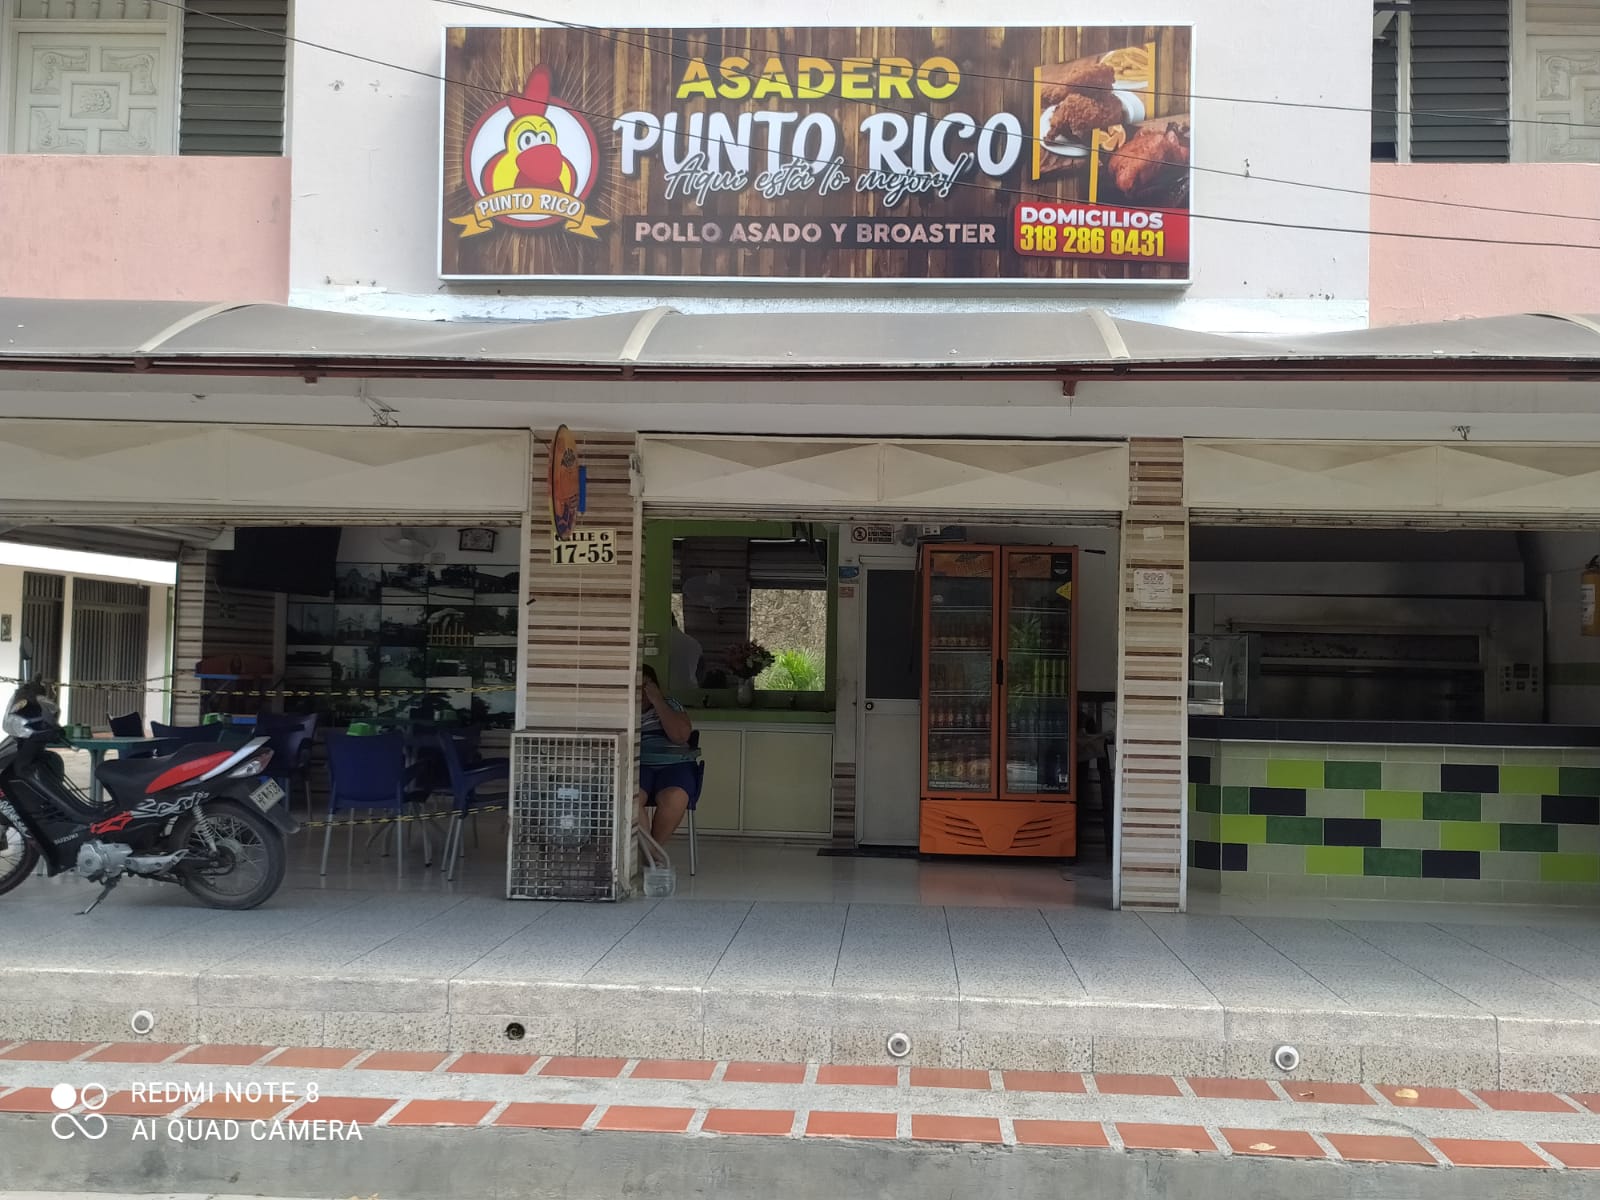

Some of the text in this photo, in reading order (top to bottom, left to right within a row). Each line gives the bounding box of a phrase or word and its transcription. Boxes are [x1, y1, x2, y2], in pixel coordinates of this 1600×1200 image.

[676, 57, 960, 99] ASADERO
[613, 111, 1022, 176] PUNTO RICO
[819, 156, 850, 196] lo
[478, 193, 581, 216] PUNTO RICO
[1020, 206, 1164, 230] DOMICILIOS
[635, 222, 996, 244] POLLO ASADO Y BROASTER
[1020, 224, 1164, 257] 318 286 9431
[600, 532, 609, 542] 6
[554, 543, 614, 564] 17-55
